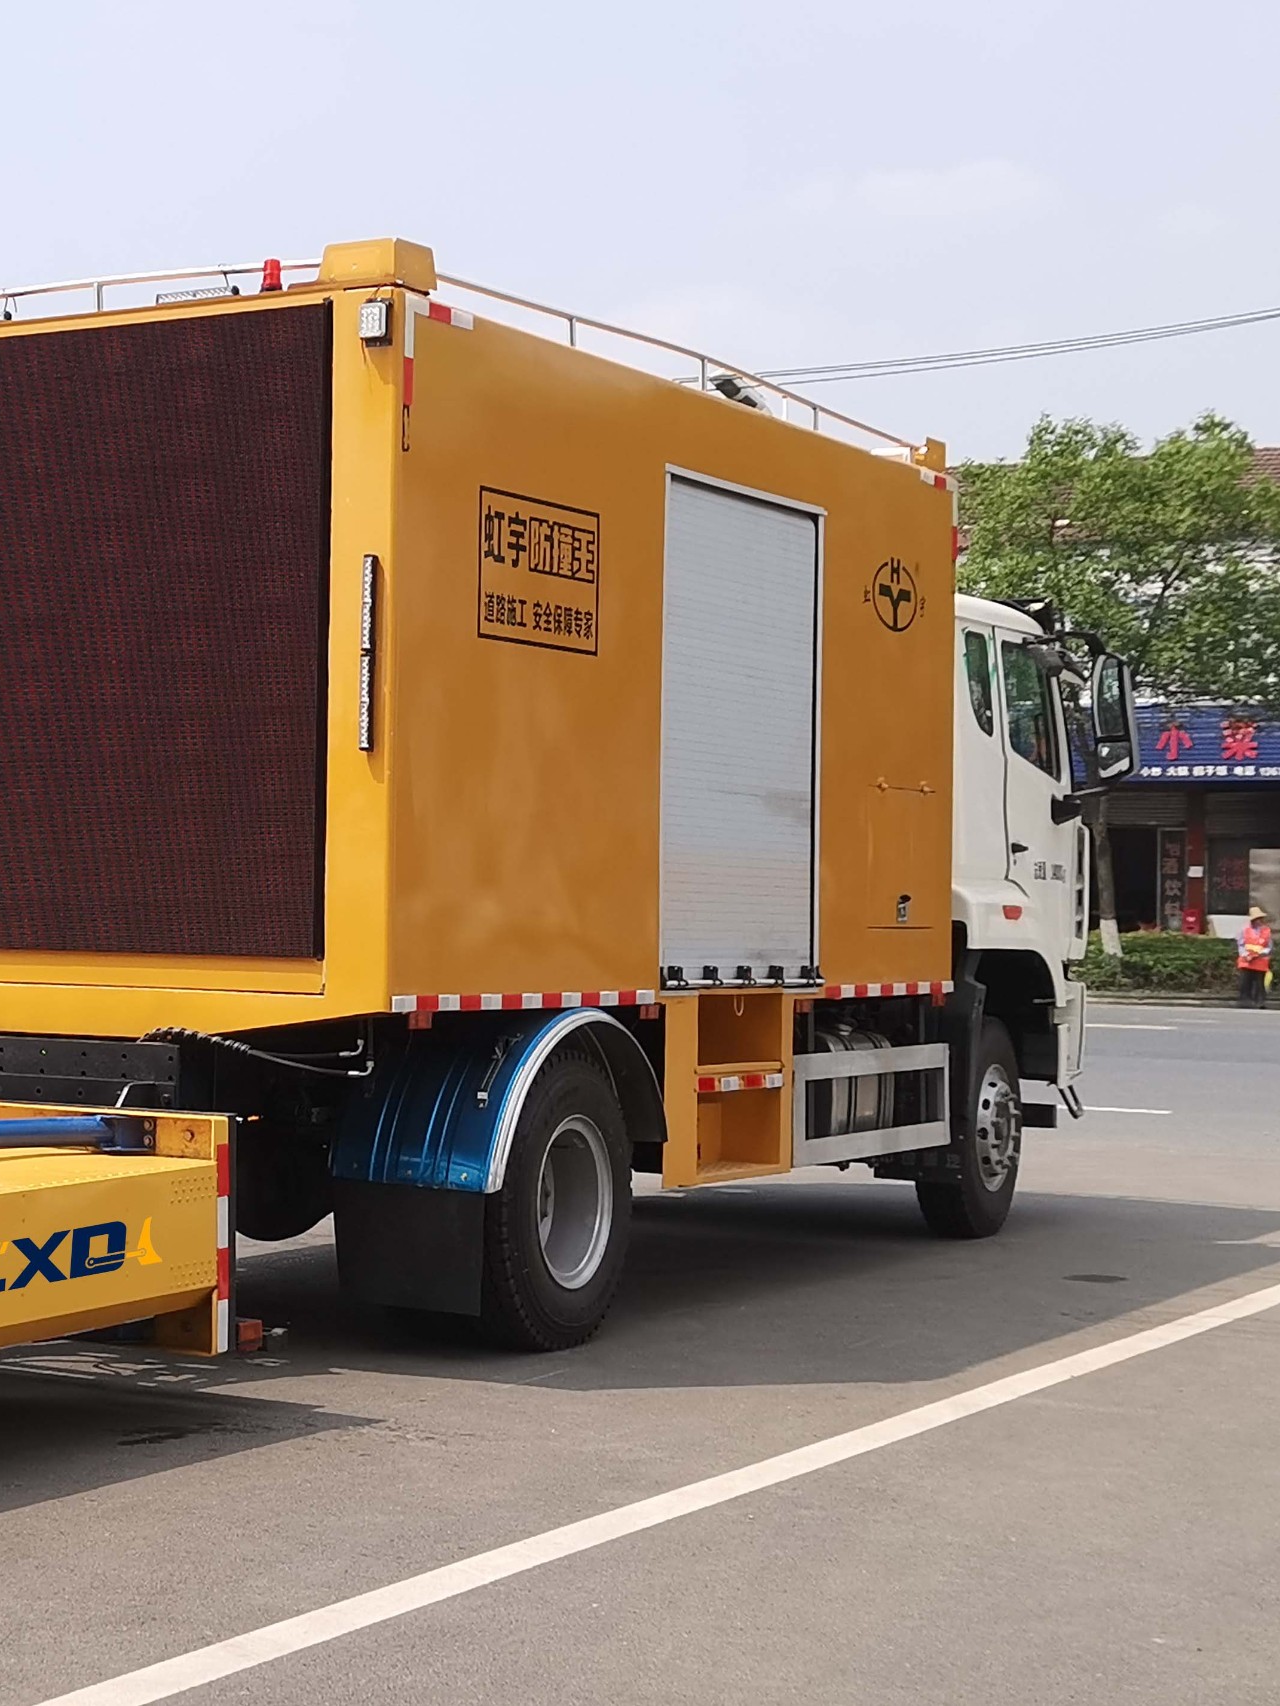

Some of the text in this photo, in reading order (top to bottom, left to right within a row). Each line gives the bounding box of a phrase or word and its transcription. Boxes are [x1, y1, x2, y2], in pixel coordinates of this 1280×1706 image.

[484, 591, 594, 640] 道路施工 安全保障专家
